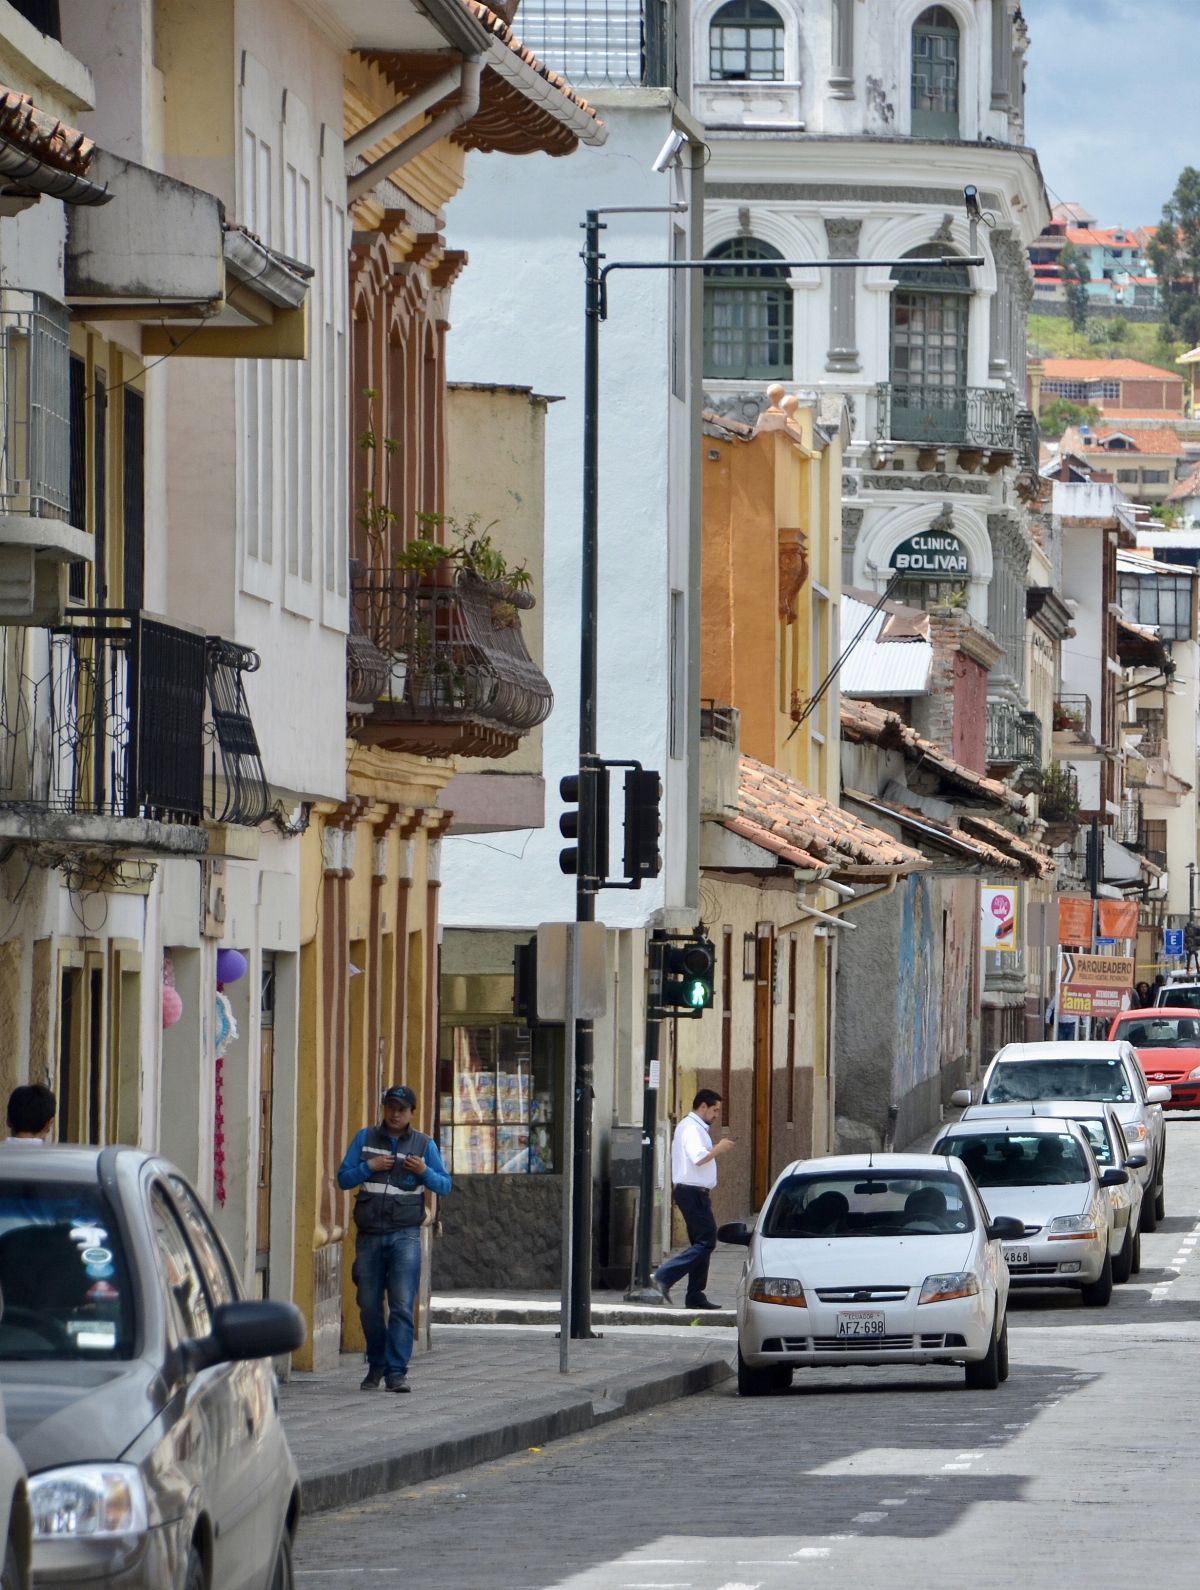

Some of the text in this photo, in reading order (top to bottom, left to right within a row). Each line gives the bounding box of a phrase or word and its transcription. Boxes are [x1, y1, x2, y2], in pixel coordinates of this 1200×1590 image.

[911, 536, 960, 551] CLINICA
[895, 553, 968, 570] BOLIVAR
[1170, 935, 1177, 945] E
[1077, 959, 1132, 974] PARQUEADERO
[1004, 1252, 1028, 1263] 4868
[839, 1320, 884, 1335] AFZ-698
